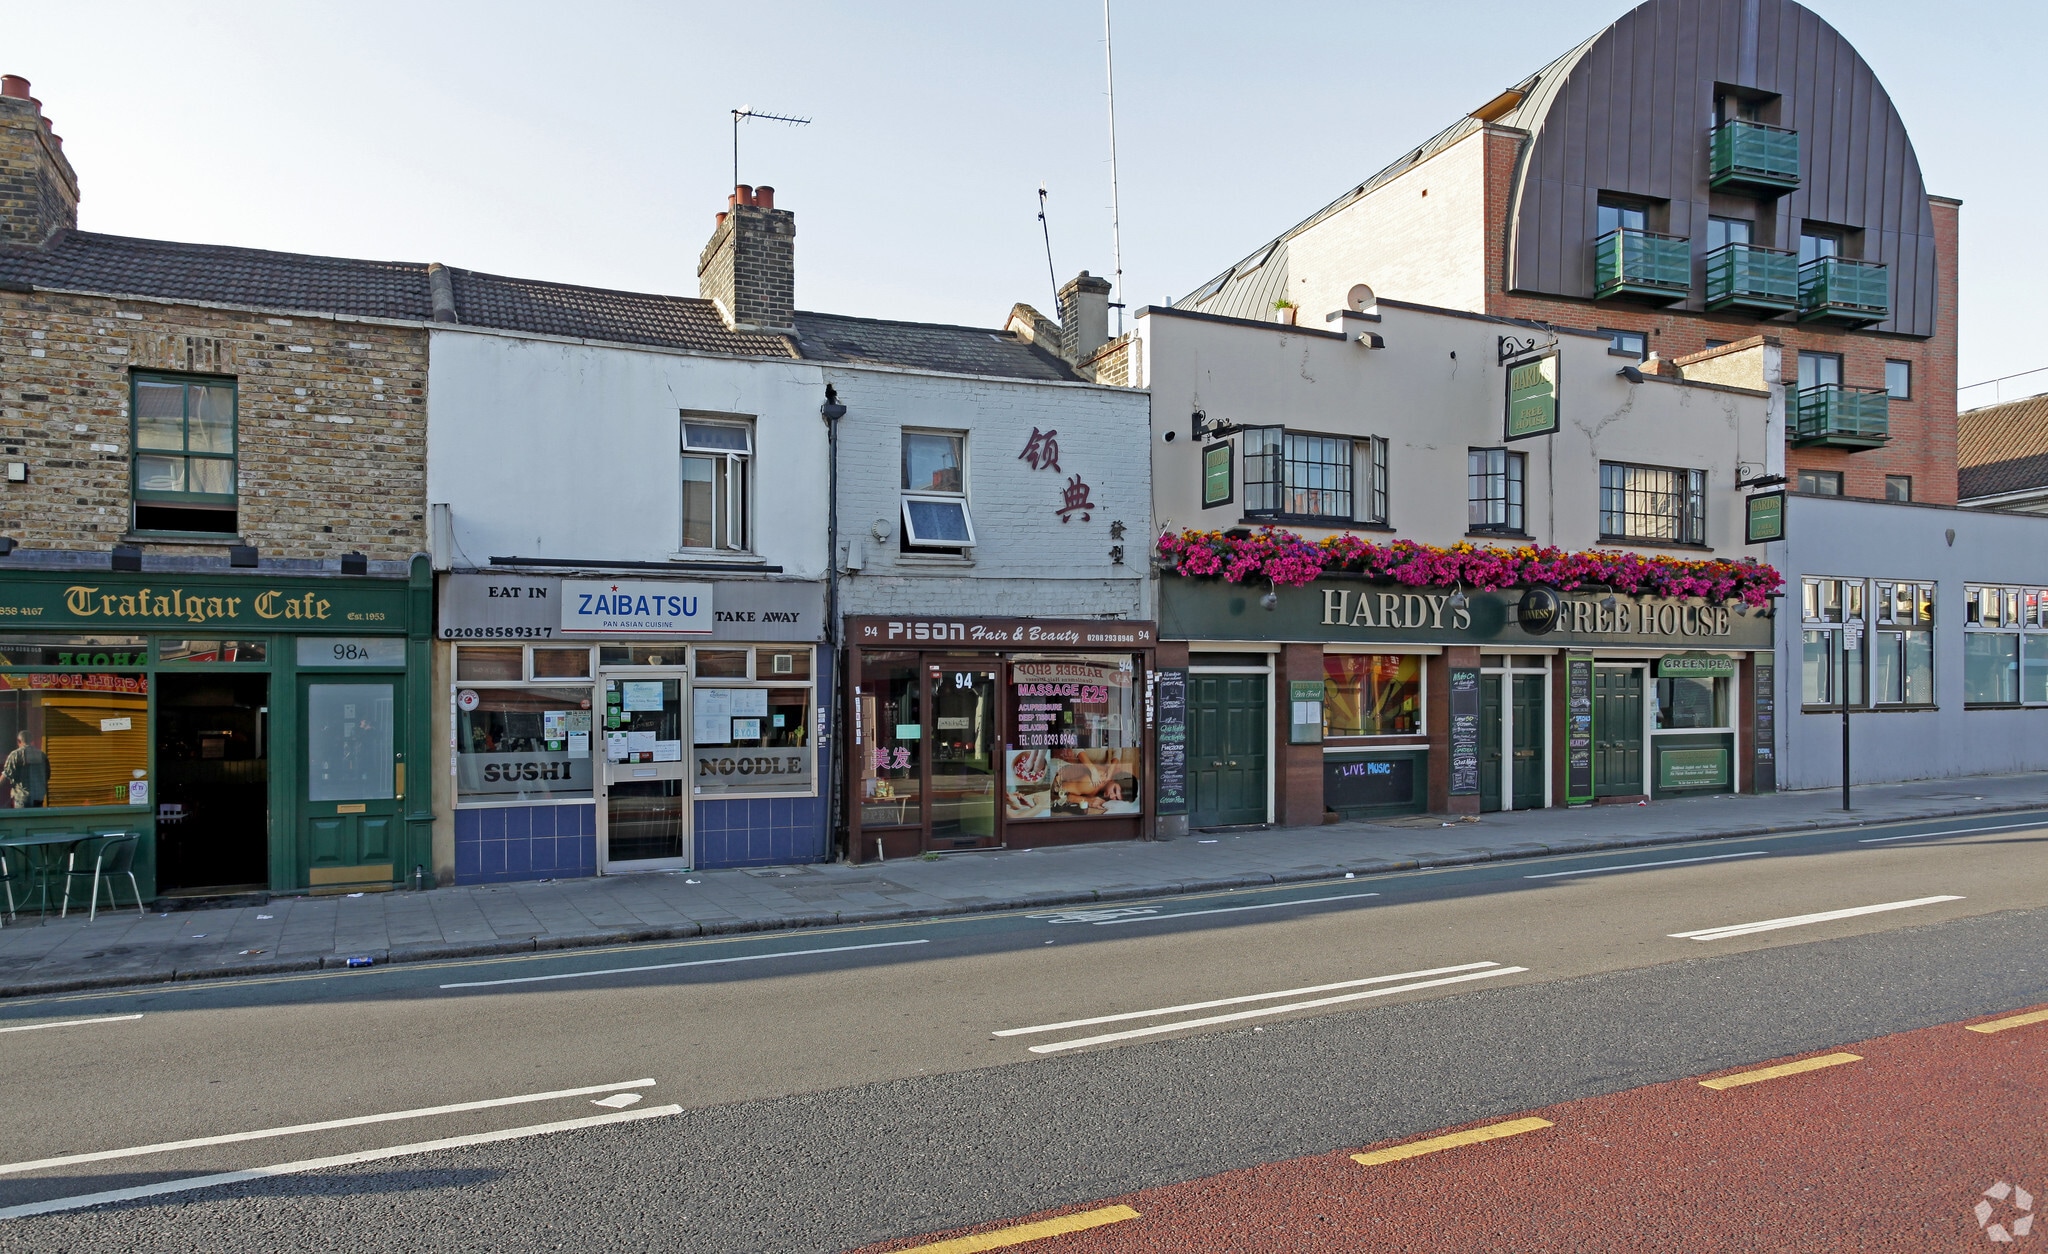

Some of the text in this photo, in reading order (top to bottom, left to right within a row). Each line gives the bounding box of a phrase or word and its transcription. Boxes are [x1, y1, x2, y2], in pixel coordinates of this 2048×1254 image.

[1521, 406, 1543, 419] FREE
[1516, 414, 1547, 431] HOUSE
[488, 586, 547, 599] EAT IN
[63, 586, 331, 623] Trafalgar Cafe
[578, 594, 697, 616] ZAIBATSU
[20, 607, 43, 616] 4167
[365, 612, 385, 621] 1953
[715, 611, 800, 623] TAKE AWAY
[1320, 589, 1731, 636] HARDY'S FREE HOUSE
[603, 620, 618, 628] PAN
[444, 627, 552, 638] 02088589317
[864, 626, 878, 637] 94
[970, 625, 1008, 640] Hair
[1012, 626, 1023, 640] &
[1028, 626, 1080, 644] Beauty
[1138, 630, 1149, 640] 94
[333, 644, 369, 660] 98A
[1663, 659, 1733, 670] GREEN PEA
[955, 672, 972, 689] 94
[1018, 684, 1108, 704] MASSAGE £25
[1018, 703, 1062, 711] ACUPRESSURE
[1018, 713, 1056, 721] DEEP TISSUE
[1018, 723, 1048, 731] RELAXING
[1019, 735, 1030, 746] TEL:
[1031, 735, 1042, 745] 020
[1043, 734, 1059, 745] 8293
[871, 747, 911, 770] 美发
[484, 756, 801, 782] SUSHI NOODLE
[1342, 762, 1391, 776] LIVE MUSIC
